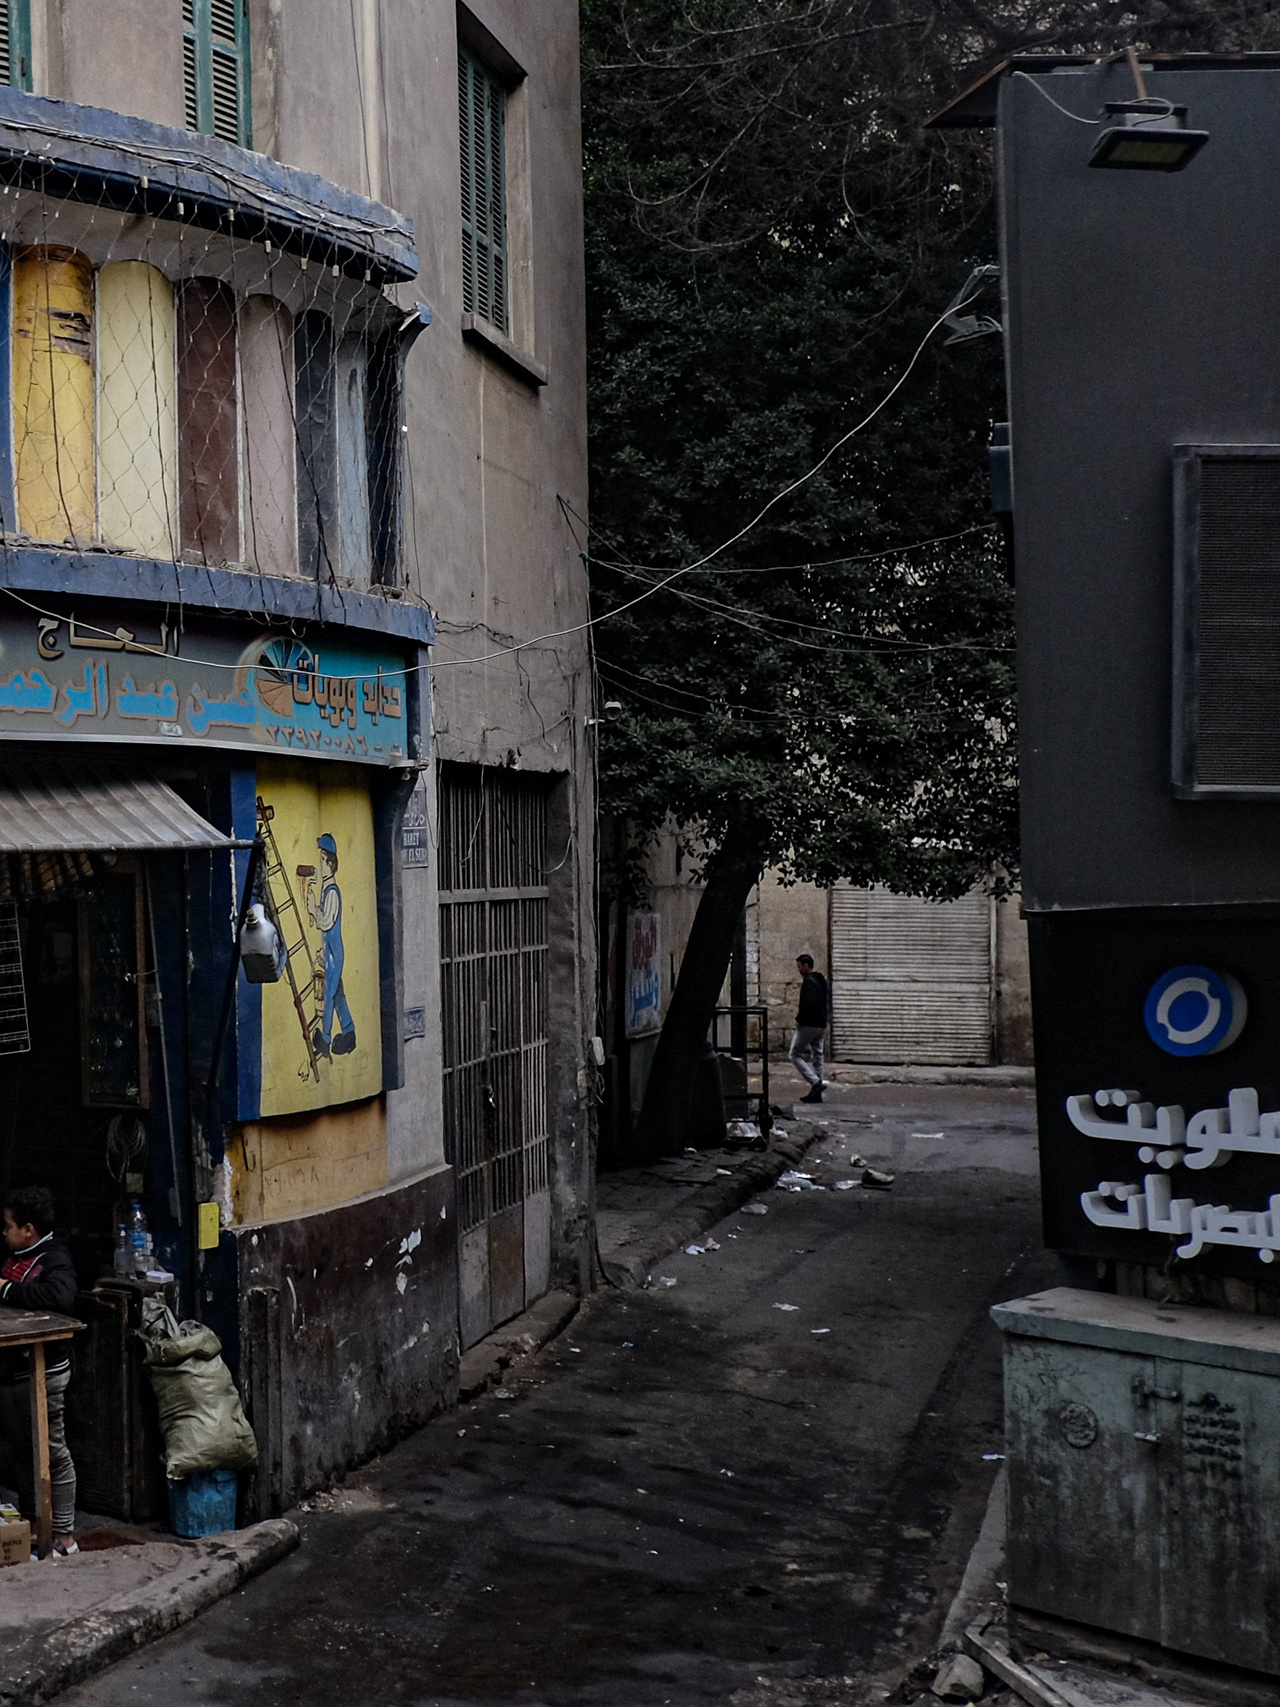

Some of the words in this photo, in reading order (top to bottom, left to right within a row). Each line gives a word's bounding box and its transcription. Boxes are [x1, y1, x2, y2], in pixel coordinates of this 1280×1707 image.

[36, 610, 179, 660] الحاج
[116, 672, 180, 728] عبد
[1066, 1086, 1280, 1171] لويت
